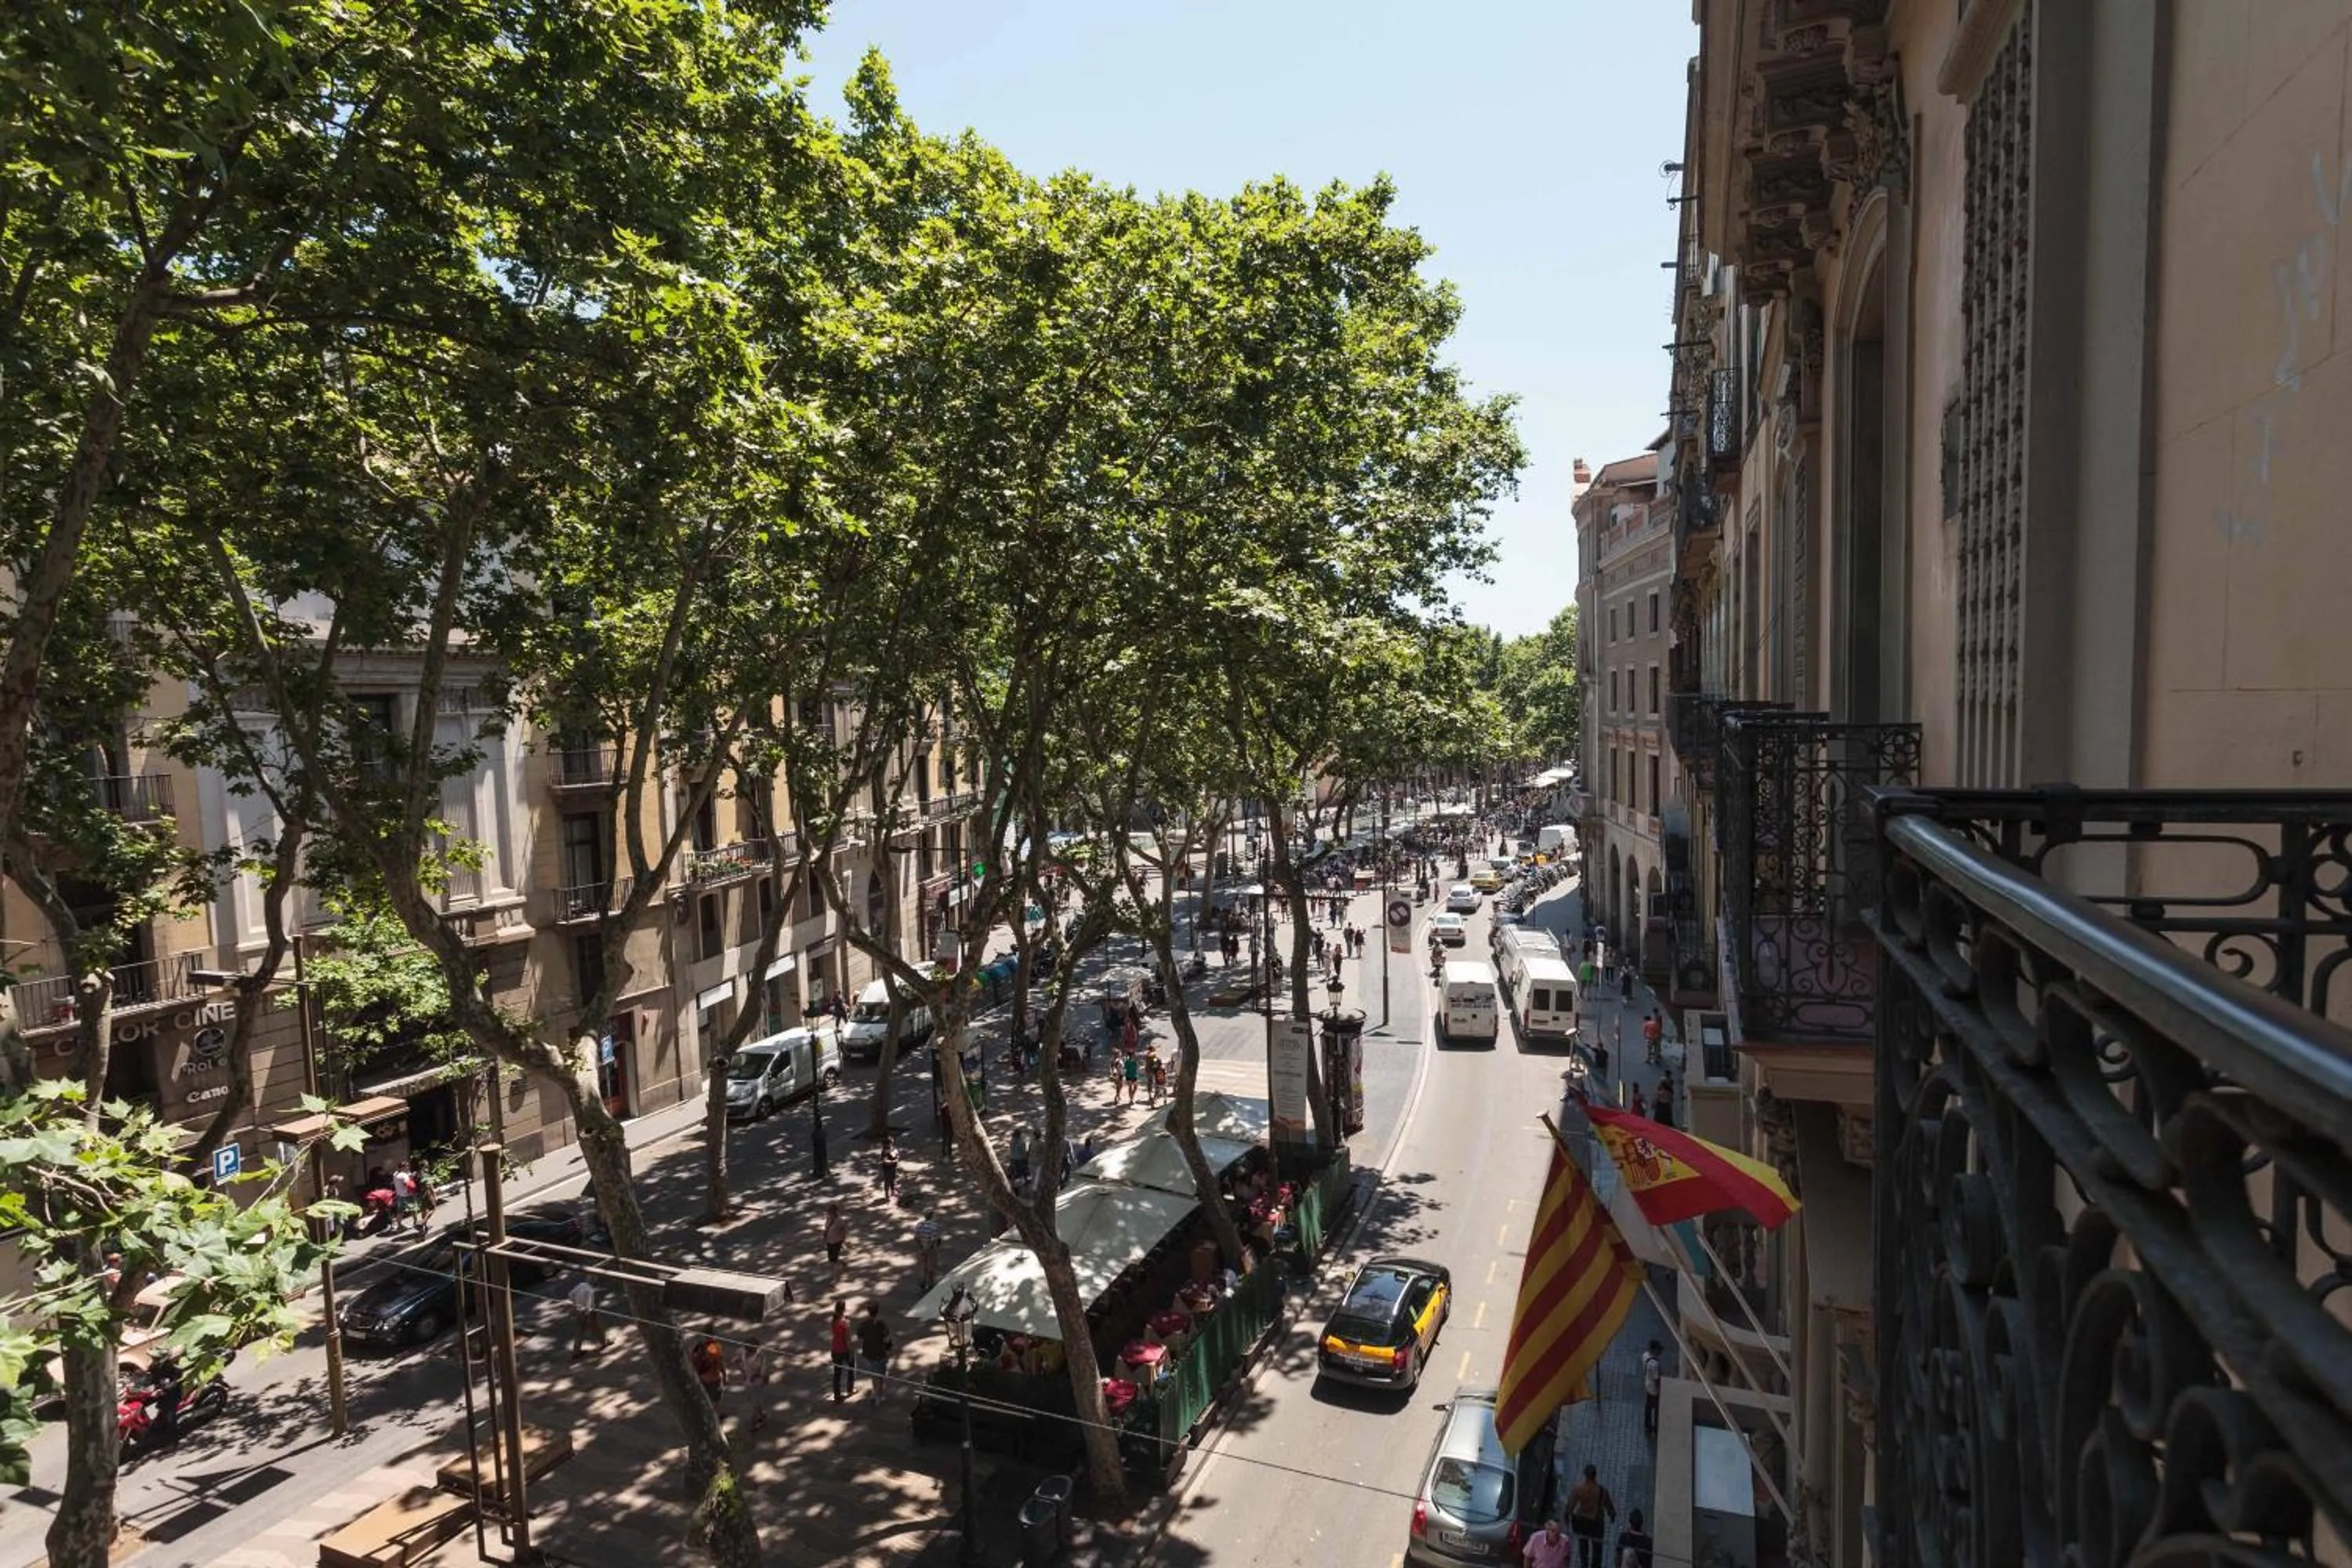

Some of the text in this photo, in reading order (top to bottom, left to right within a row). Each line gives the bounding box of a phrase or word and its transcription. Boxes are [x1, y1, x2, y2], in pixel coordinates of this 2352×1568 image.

[53, 1002, 236, 1056] COR CINE
[187, 1086, 230, 1104] Cano
[220, 1149, 234, 1175] P
